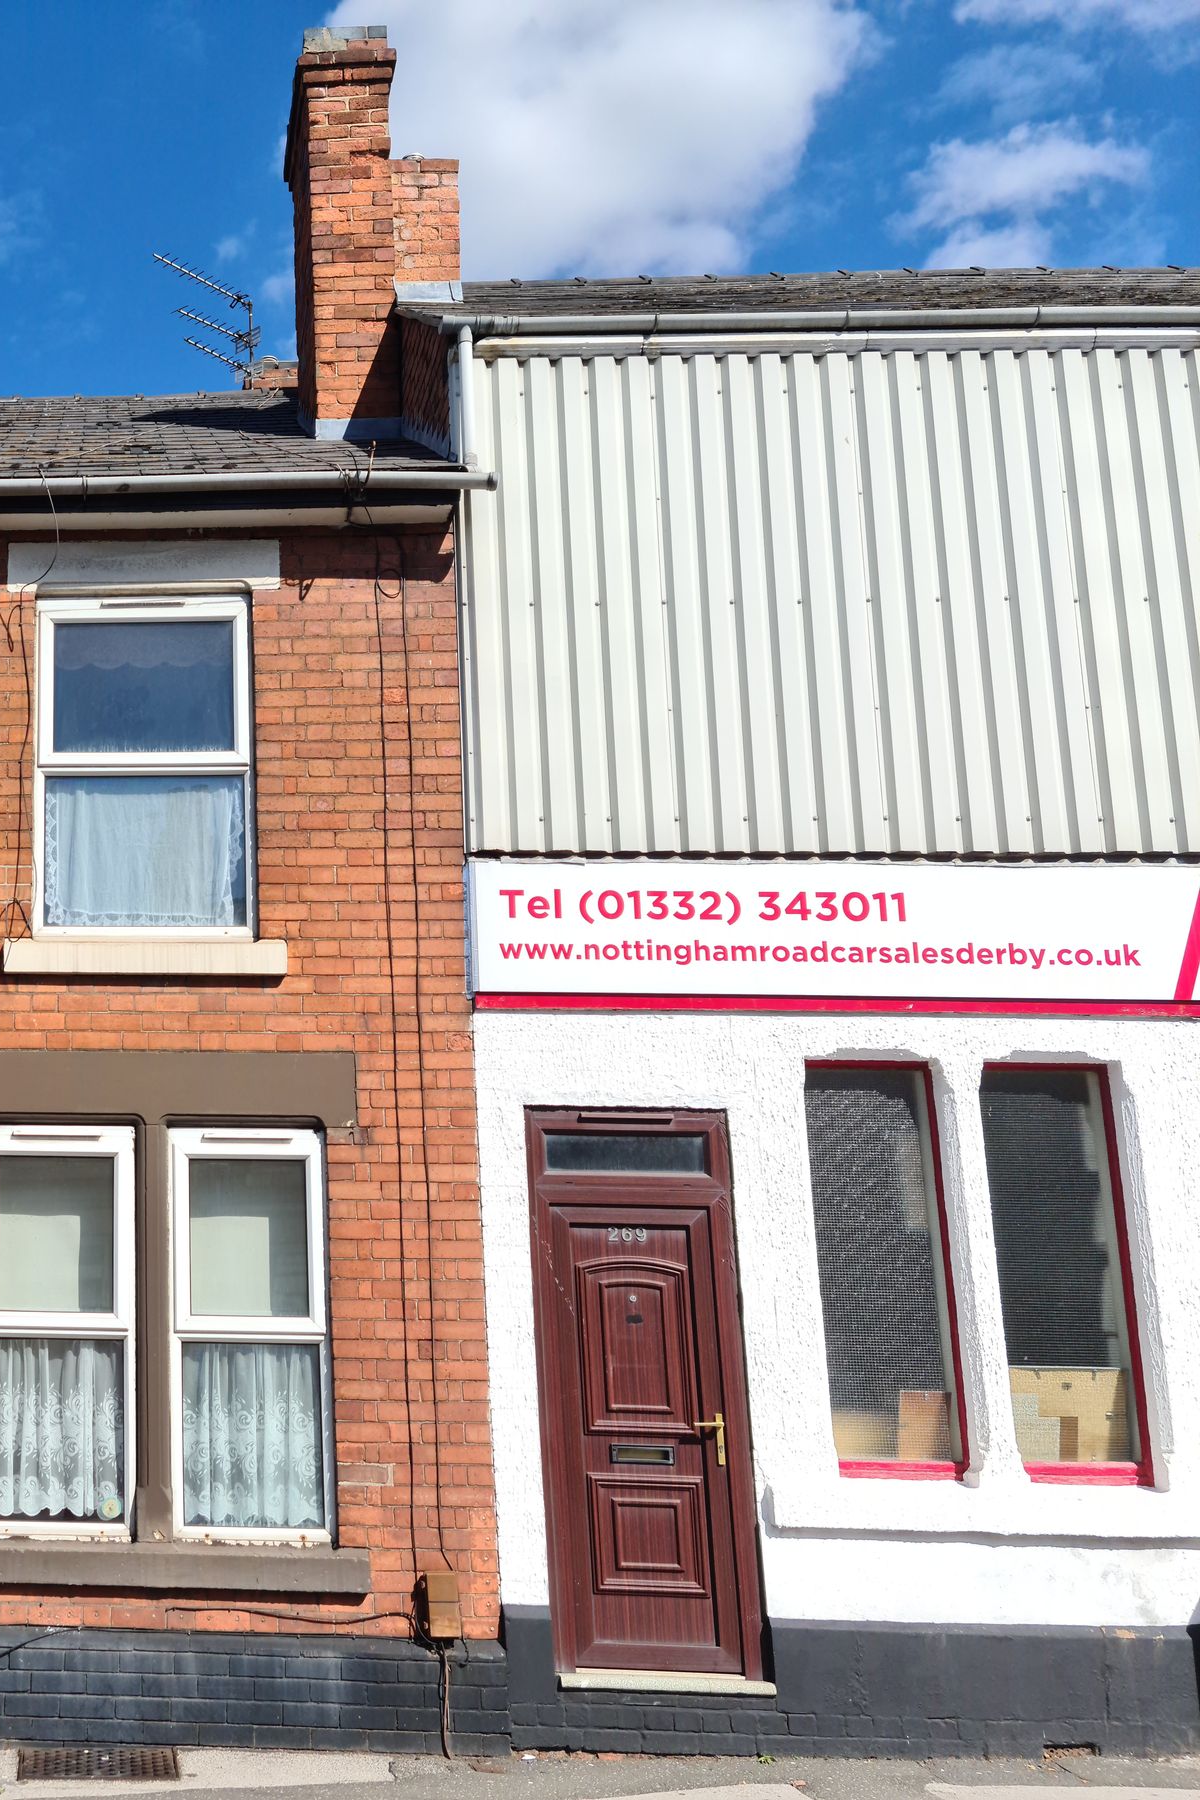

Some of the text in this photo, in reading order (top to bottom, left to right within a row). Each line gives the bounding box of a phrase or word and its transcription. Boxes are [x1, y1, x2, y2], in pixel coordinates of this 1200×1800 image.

[499, 888, 908, 926] Tel (01332) 343011
[499, 939, 1142, 971] www.nottinghamroadcarsalesderby.co.uk
[607, 1227, 647, 1242] 269
